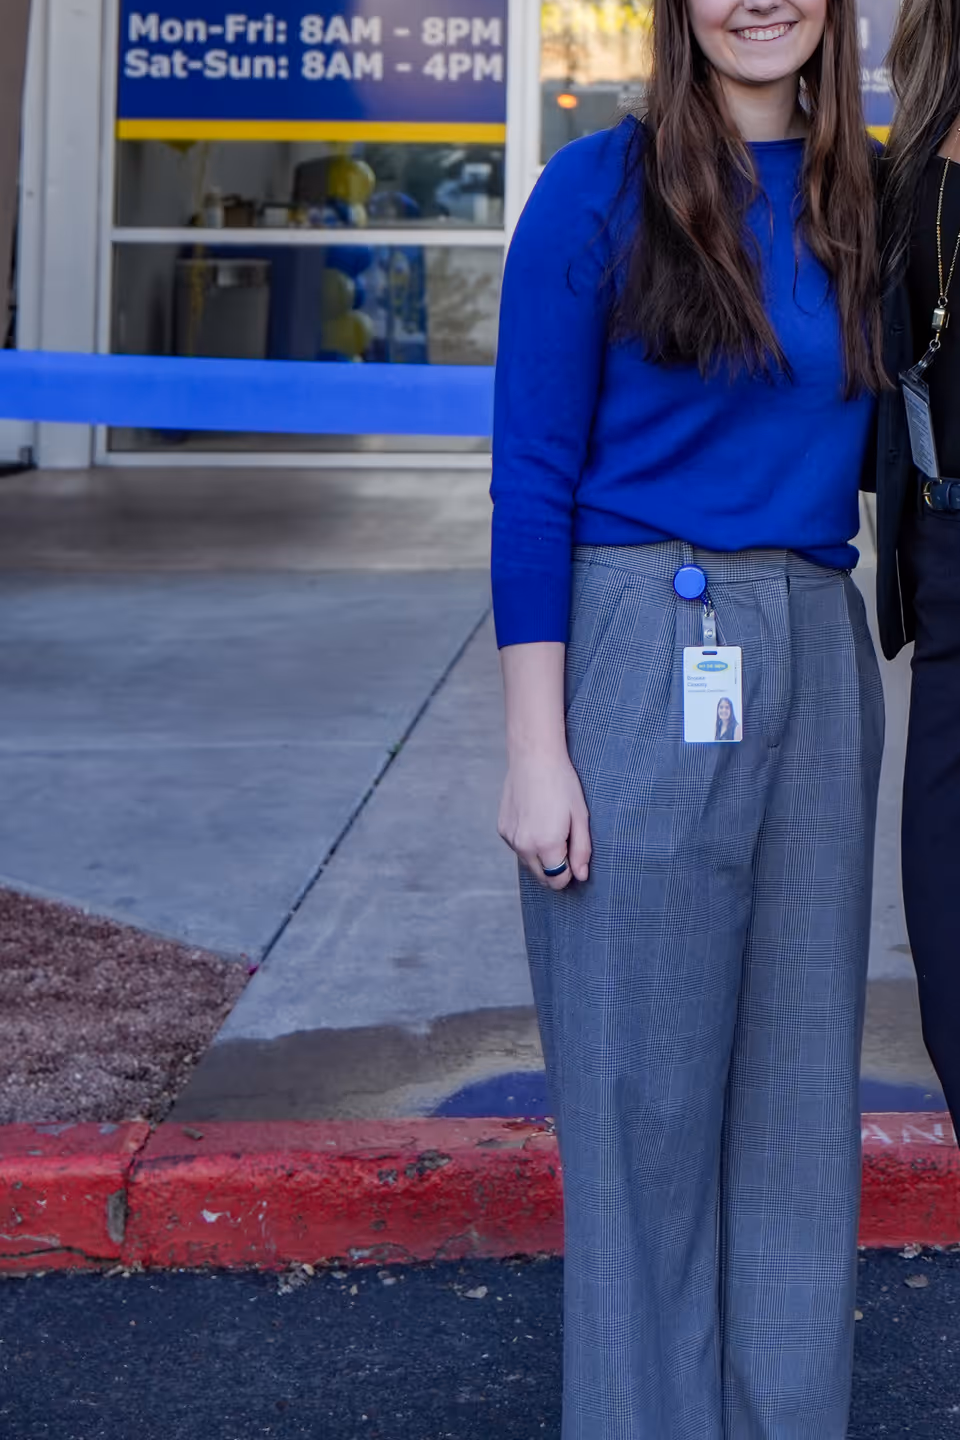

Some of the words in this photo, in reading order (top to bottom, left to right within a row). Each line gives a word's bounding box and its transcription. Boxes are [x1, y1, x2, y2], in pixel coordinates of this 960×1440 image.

[128, 13, 287, 44] Mon-Fri:
[300, 16, 382, 45] 8AM
[421, 17, 502, 46] 8PM
[124, 49, 289, 79] Sat-Sun:
[301, 51, 383, 80] 8AM
[423, 52, 502, 82] 4PM
